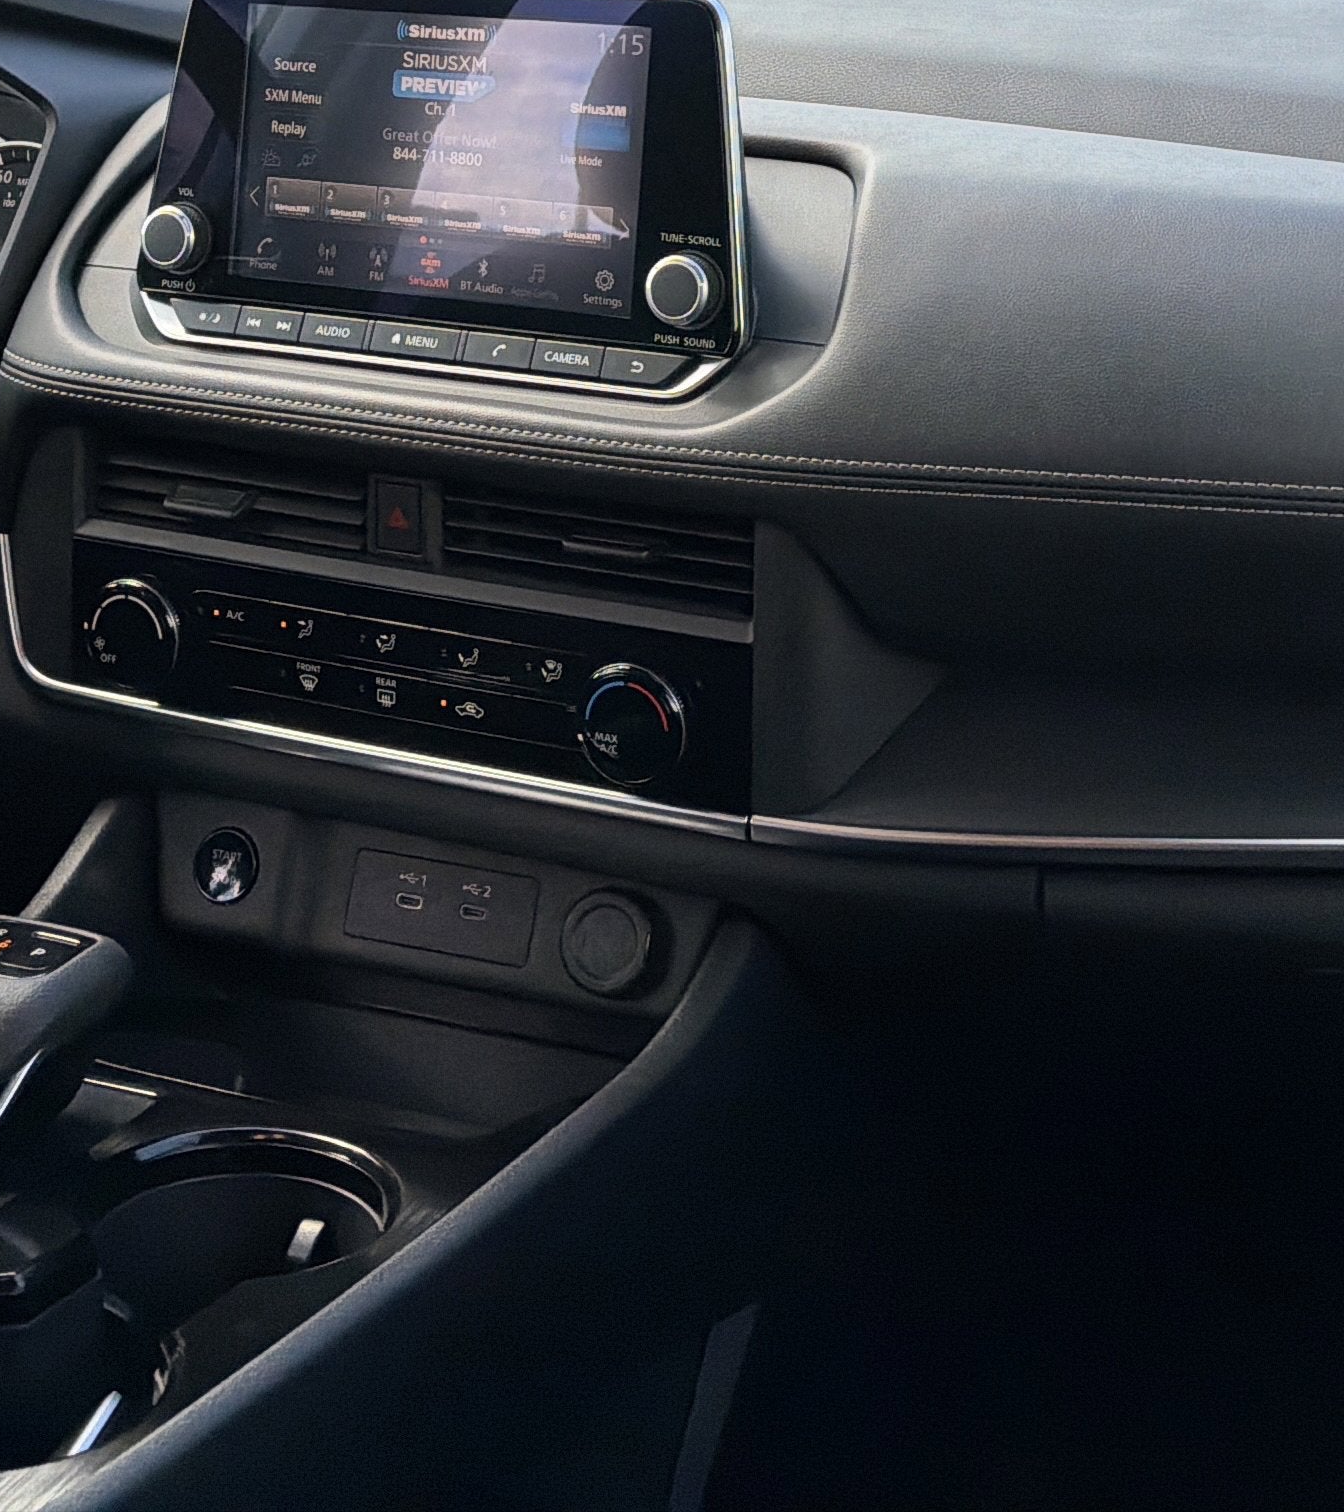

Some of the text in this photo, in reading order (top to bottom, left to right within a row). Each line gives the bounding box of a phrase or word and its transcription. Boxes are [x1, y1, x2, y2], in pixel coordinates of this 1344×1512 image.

[597, 32, 644, 55] 1:15
[274, 57, 317, 73] Source
[403, 51, 486, 73] SIRIUSXM
[401, 76, 486, 97] PREVIEW
[264, 88, 322, 105] SXM Menu
[271, 120, 306, 138] Replay
[382, 127, 418, 143] Great
[392, 147, 483, 167] 844-711-8800
[178, 187, 194, 198] VOL
[249, 258, 278, 270] Phone
[316, 266, 335, 277] AM
[369, 270, 384, 281] FM
[161, 278, 183, 290] PUSH
[460, 280, 473, 292] BT
[474, 282, 504, 295] Audio
[582, 293, 623, 309] Settings
[315, 324, 351, 339] AUDIO
[404, 334, 439, 349] MENU
[654, 333, 716, 349] PUSH SOUND
[544, 351, 590, 367] CAMERA
[226, 609, 245, 622] A/C
[100, 653, 117, 664] OFF
[296, 661, 321, 673] FRONT
[375, 676, 397, 688] REAR
[594, 732, 618, 744] MAX
[483, 885, 492, 898] 2
[30, 947, 46, 956] P
